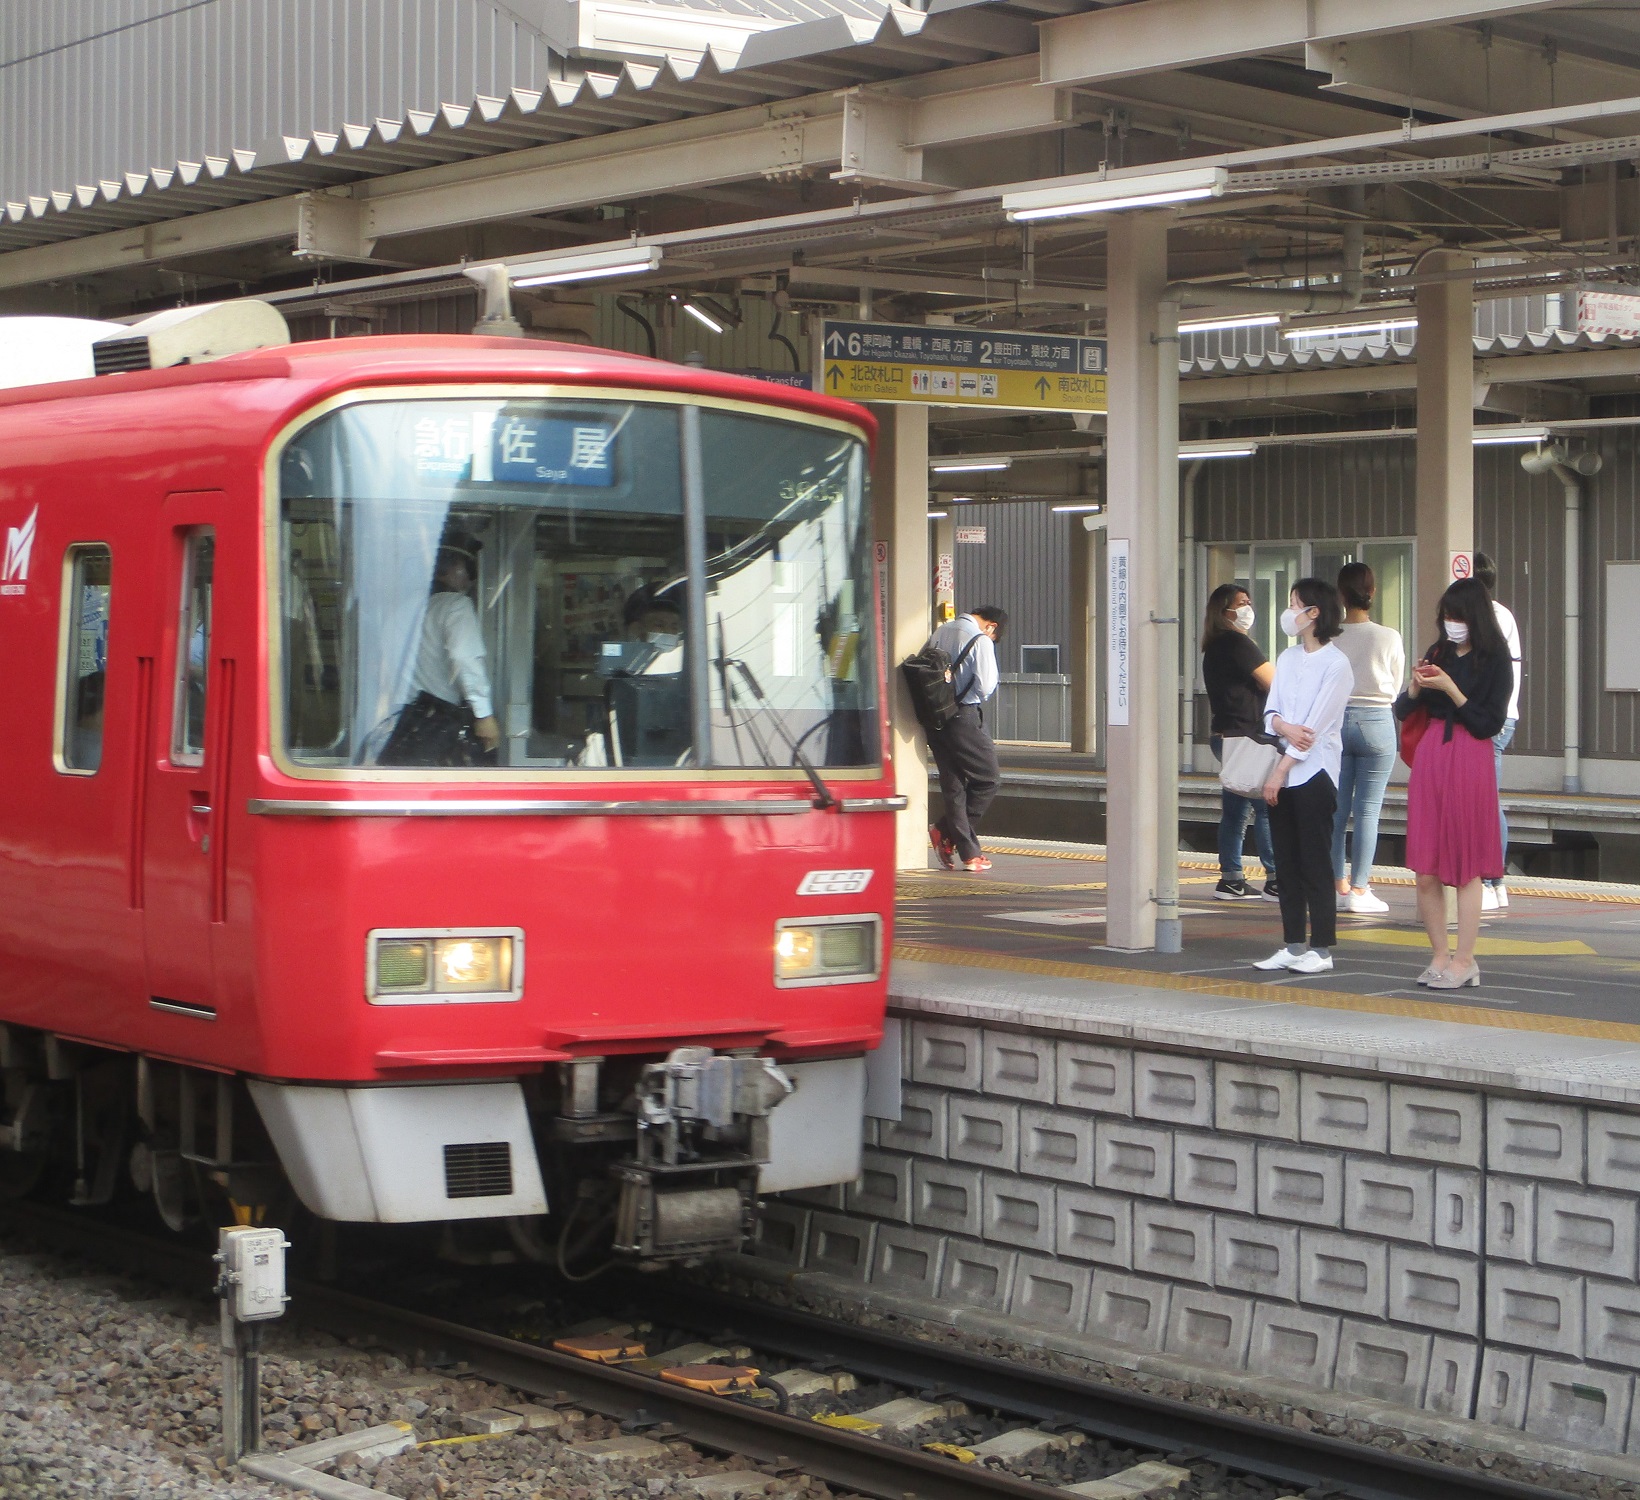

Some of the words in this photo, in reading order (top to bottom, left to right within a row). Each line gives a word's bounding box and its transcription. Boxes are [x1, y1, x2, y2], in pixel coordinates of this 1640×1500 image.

[848, 332, 861, 356] 6
[953, 339, 973, 354] 方面
[862, 348, 871, 356] for
[872, 349, 892, 359] Higashi
[980, 341, 992, 364] 2
[1051, 346, 1070, 360] 方面
[1034, 359, 1058, 369] Sanage
[765, 374, 804, 387] Transfer
[850, 364, 904, 383] 北改札口
[980, 374, 996, 382] TAXI
[850, 383, 872, 393] North
[874, 383, 898, 394] Gates
[1058, 376, 1106, 393] 南改札口
[1062, 393, 1083, 403] South
[1086, 394, 1106, 404] Gates
[414, 416, 470, 459] 急行
[536, 466, 568, 481] Saya
